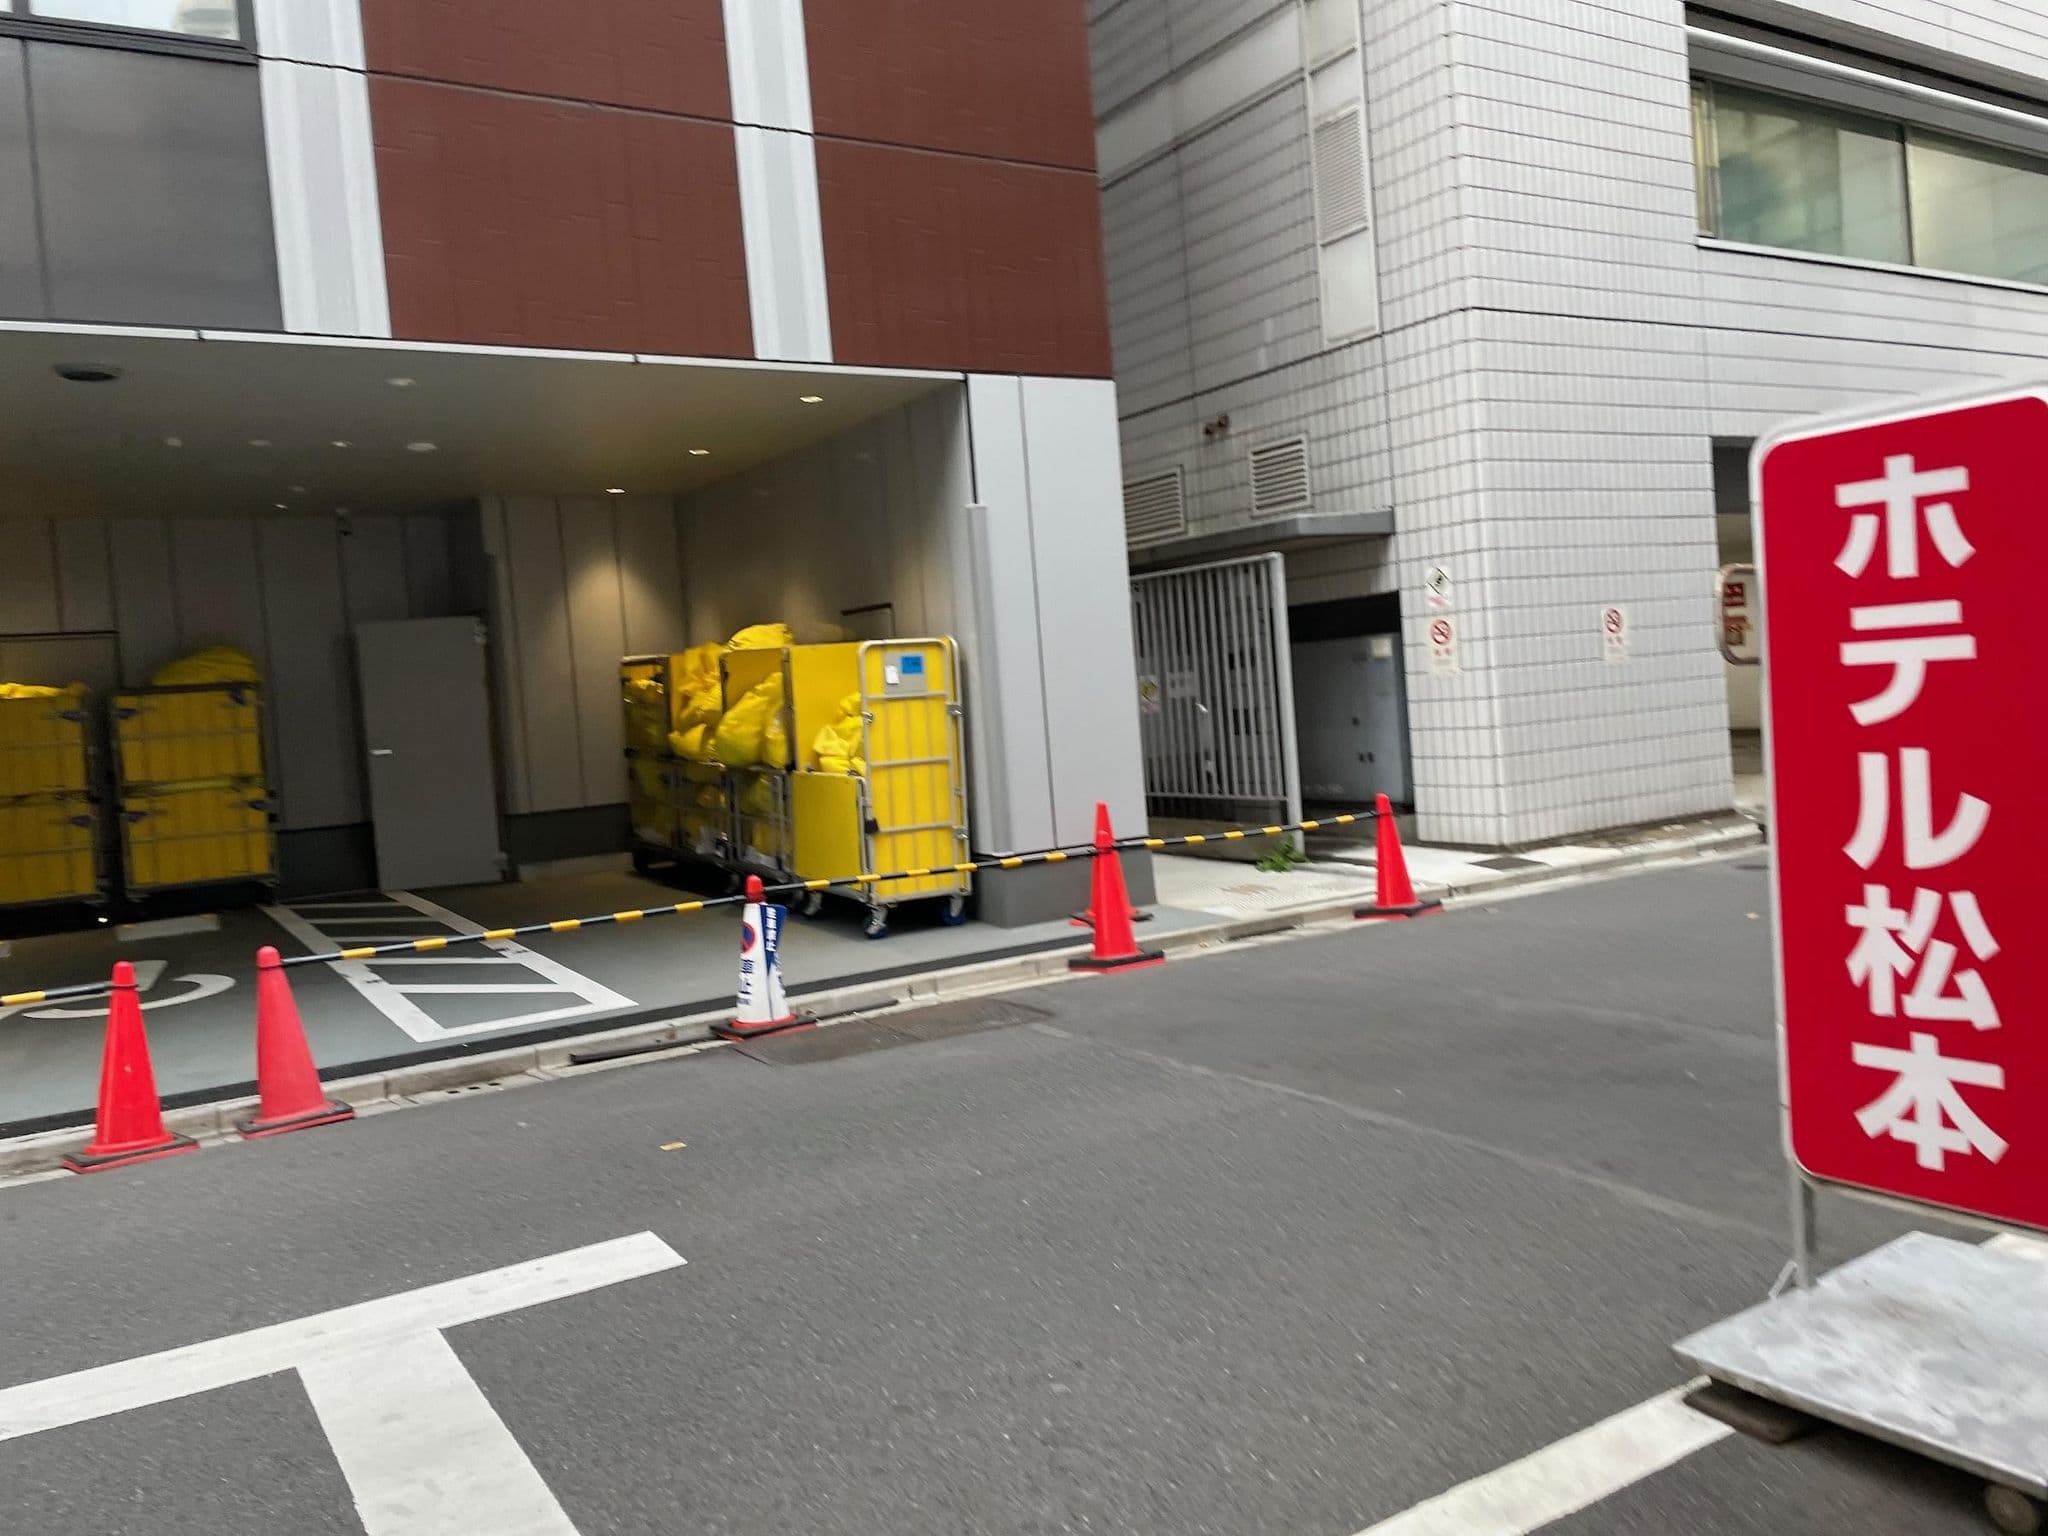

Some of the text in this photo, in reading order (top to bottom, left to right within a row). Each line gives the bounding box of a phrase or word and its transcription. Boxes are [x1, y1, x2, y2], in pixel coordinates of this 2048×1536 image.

[1834, 453, 2010, 1172] ホテル松本
